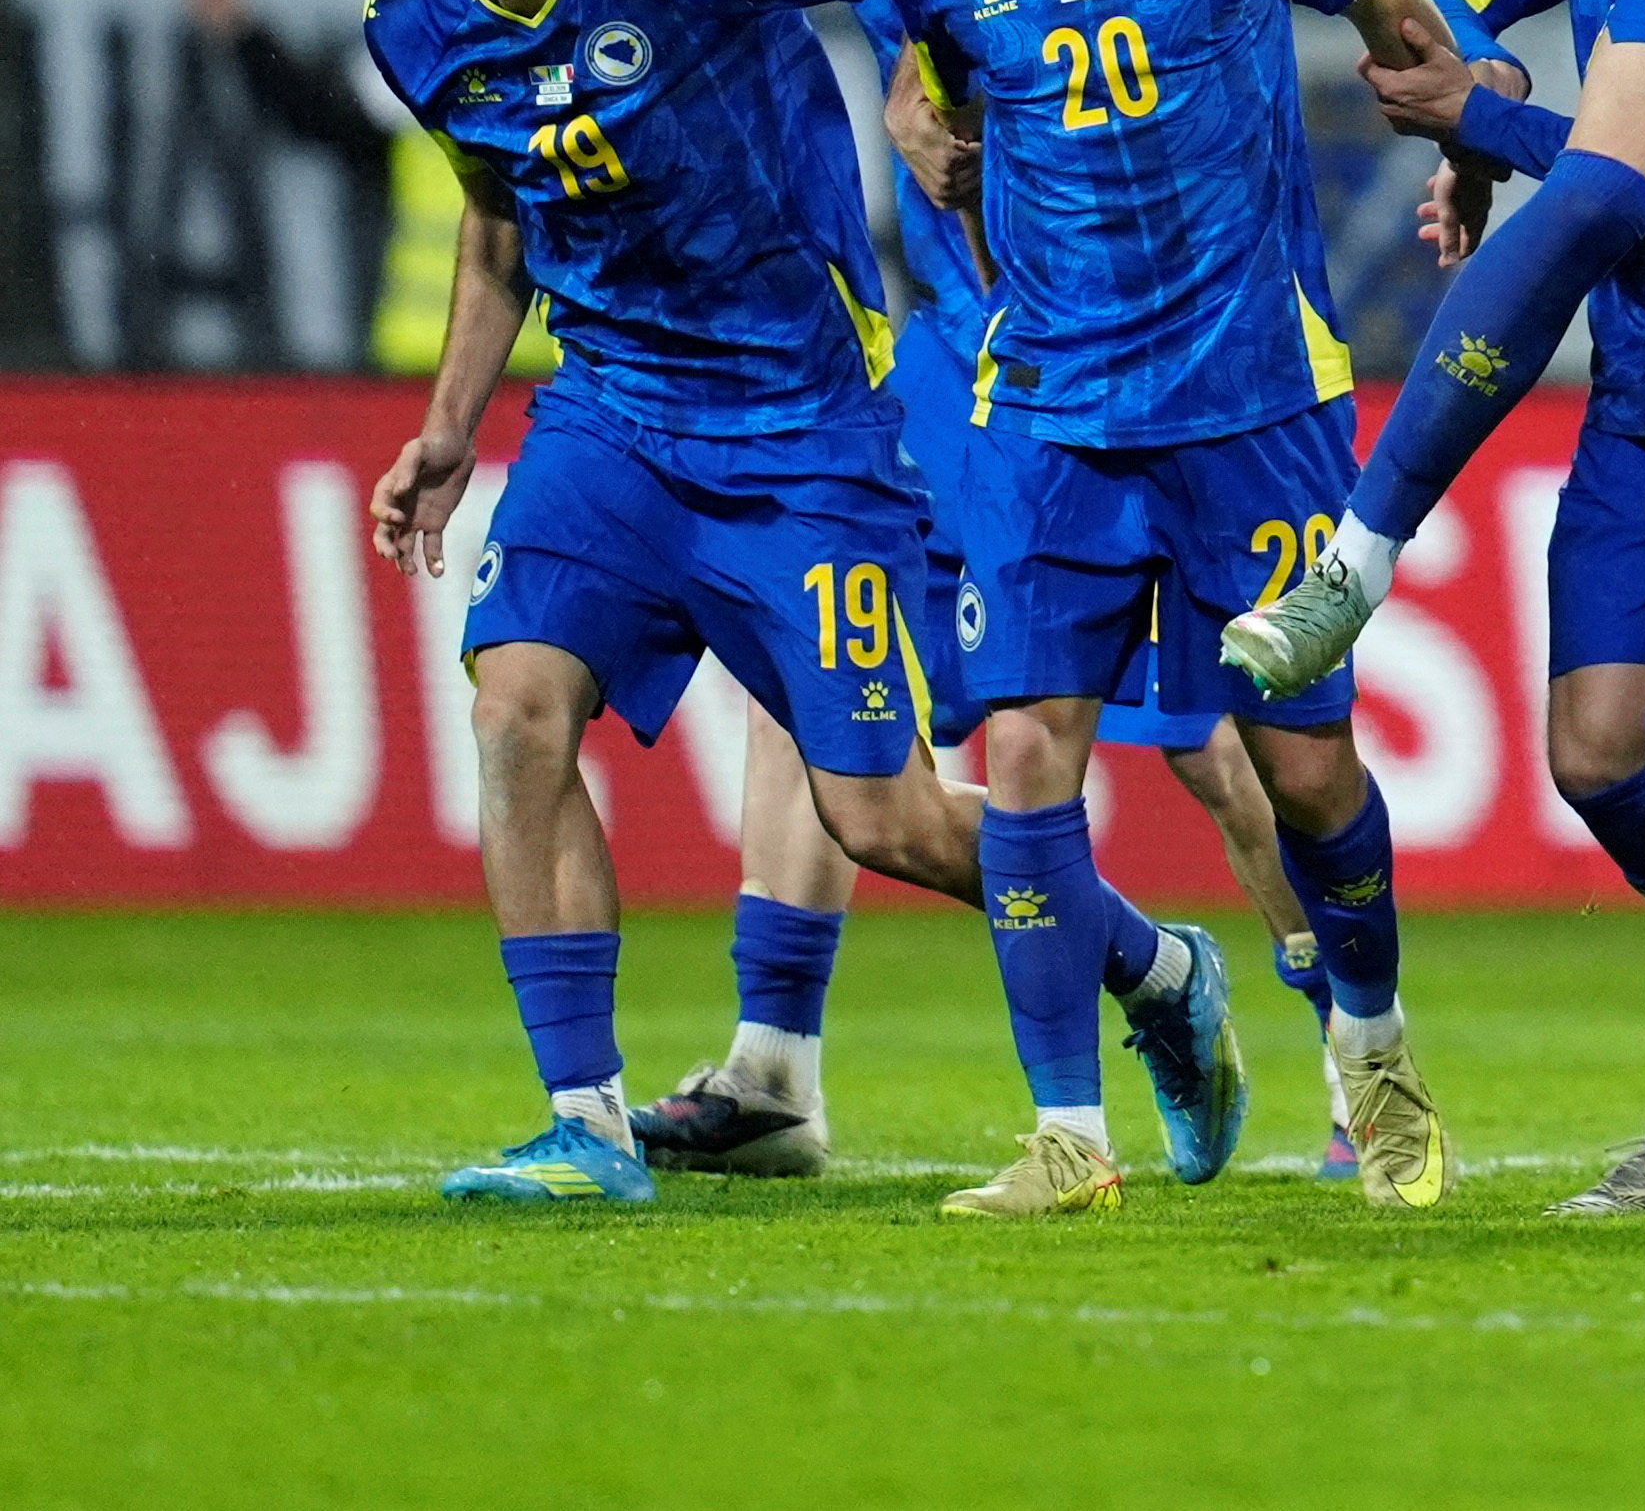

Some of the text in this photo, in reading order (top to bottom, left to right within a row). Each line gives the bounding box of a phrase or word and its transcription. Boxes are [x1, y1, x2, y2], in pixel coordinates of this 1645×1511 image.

[974, 0, 1018, 21] KELME
[1042, 16, 1159, 131] 20
[528, 114, 631, 200] 19
[1435, 351, 1498, 397] KELME
[804, 562, 889, 670] 19
[851, 711, 896, 722] KELME
[993, 916, 1057, 931] KELME
